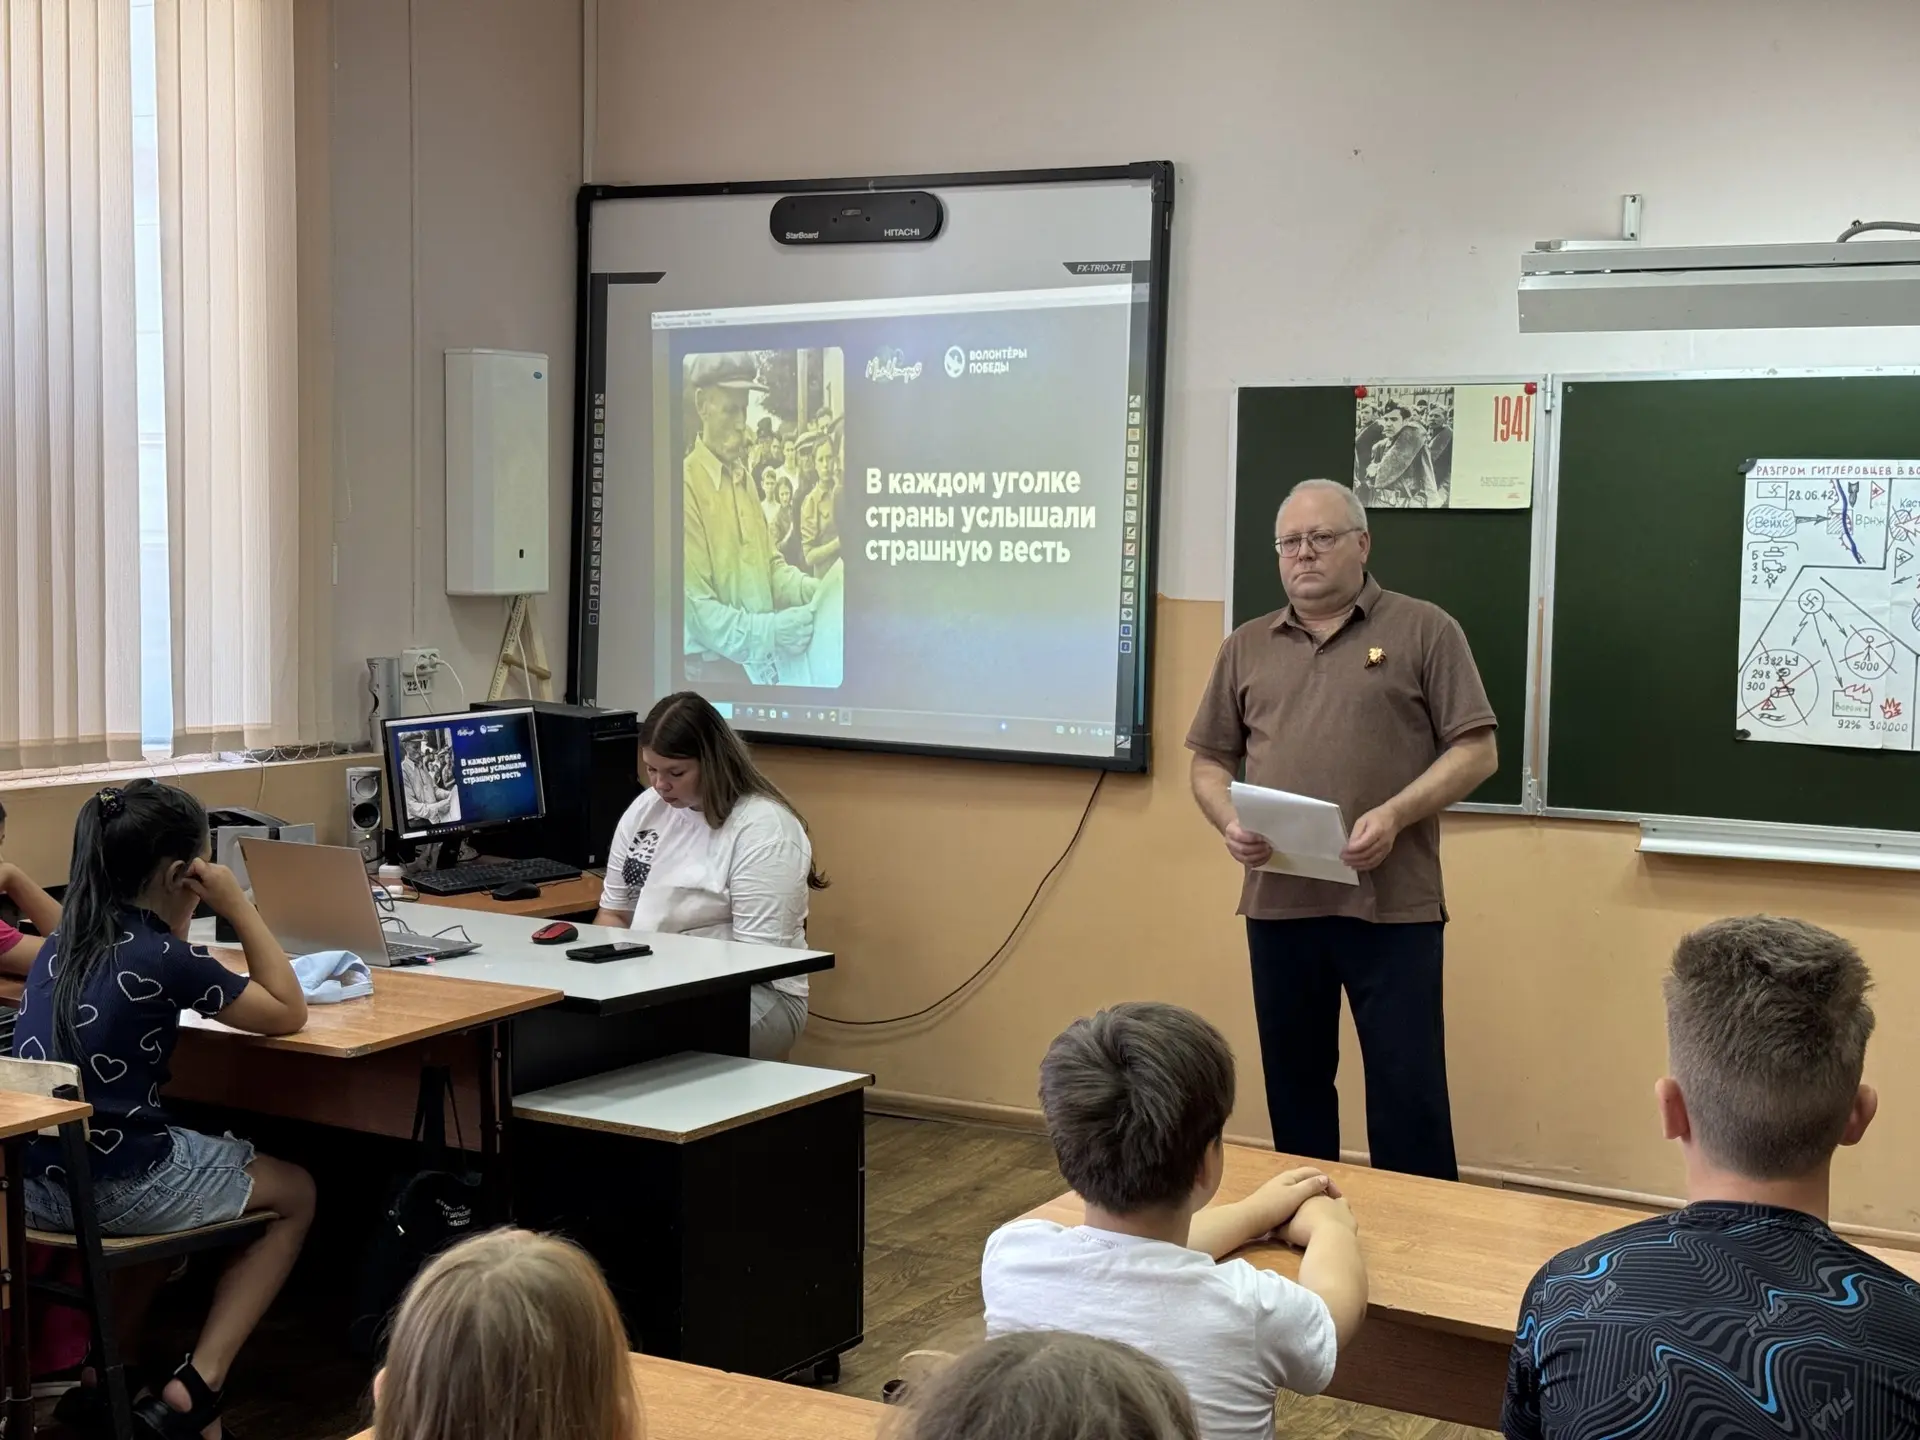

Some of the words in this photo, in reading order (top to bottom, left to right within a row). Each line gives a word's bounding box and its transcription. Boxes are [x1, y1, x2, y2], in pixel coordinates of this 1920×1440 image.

[786, 231, 819, 240] StarBoard
[884, 228, 920, 237] HITACHI
[1077, 263, 1126, 272] FX-TRIO-77E
[969, 362, 1009, 375] ПОБЕДЫ
[1493, 395, 1531, 442] 1941
[1756, 466, 1806, 476] РАЗГРОМ
[1811, 466, 1892, 476] ГИТЛЕРОВЦЕВ
[866, 468, 883, 494] В
[888, 471, 985, 498] каждом
[992, 470, 1082, 499] уголке
[865, 505, 955, 533] страны
[961, 505, 1096, 533] услышали
[865, 539, 993, 568] страшную
[999, 540, 1071, 564] весть
[1853, 661, 1880, 671] 5000
[1746, 681, 1766, 691] 300
[1837, 719, 1861, 730] 92%
[460, 758, 467, 767] В
[467, 756, 496, 766] каждом
[497, 753, 522, 764] уголке
[462, 766, 489, 776] страны
[489, 761, 527, 773] услышали
[463, 773, 500, 785] страшную
[501, 771, 522, 780] весть
[1582, 1279, 1617, 1320] FILA
[1745, 1297, 1788, 1338] FILA
[1627, 1359, 1669, 1403] FILA
